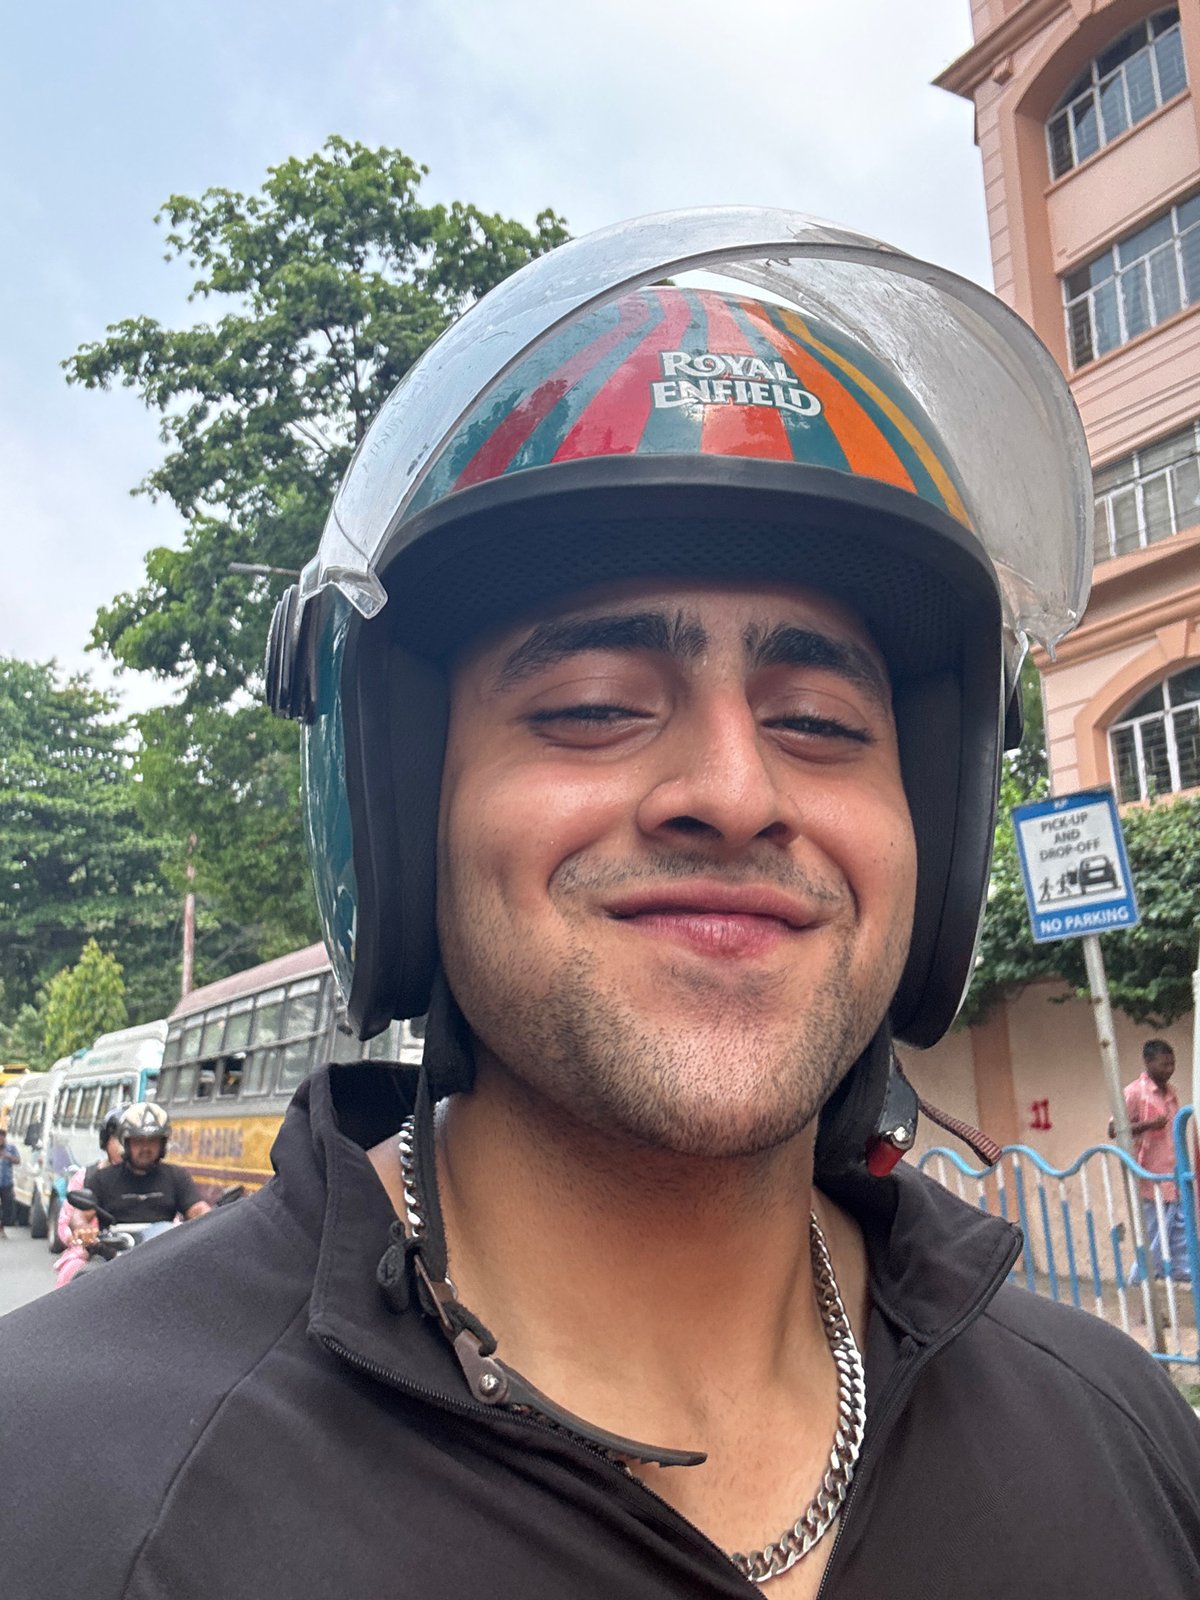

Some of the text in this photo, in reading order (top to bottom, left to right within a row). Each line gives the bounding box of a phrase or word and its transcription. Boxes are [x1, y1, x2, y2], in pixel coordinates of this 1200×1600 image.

[661, 351, 799, 384] ROYAL
[652, 380, 821, 415] ENFIELD
[1040, 811, 1089, 832] PICK-UP
[1054, 828, 1081, 844] AND
[1039, 837, 1101, 862] DROP-OFF
[1040, 906, 1129, 934] NO PARKING
